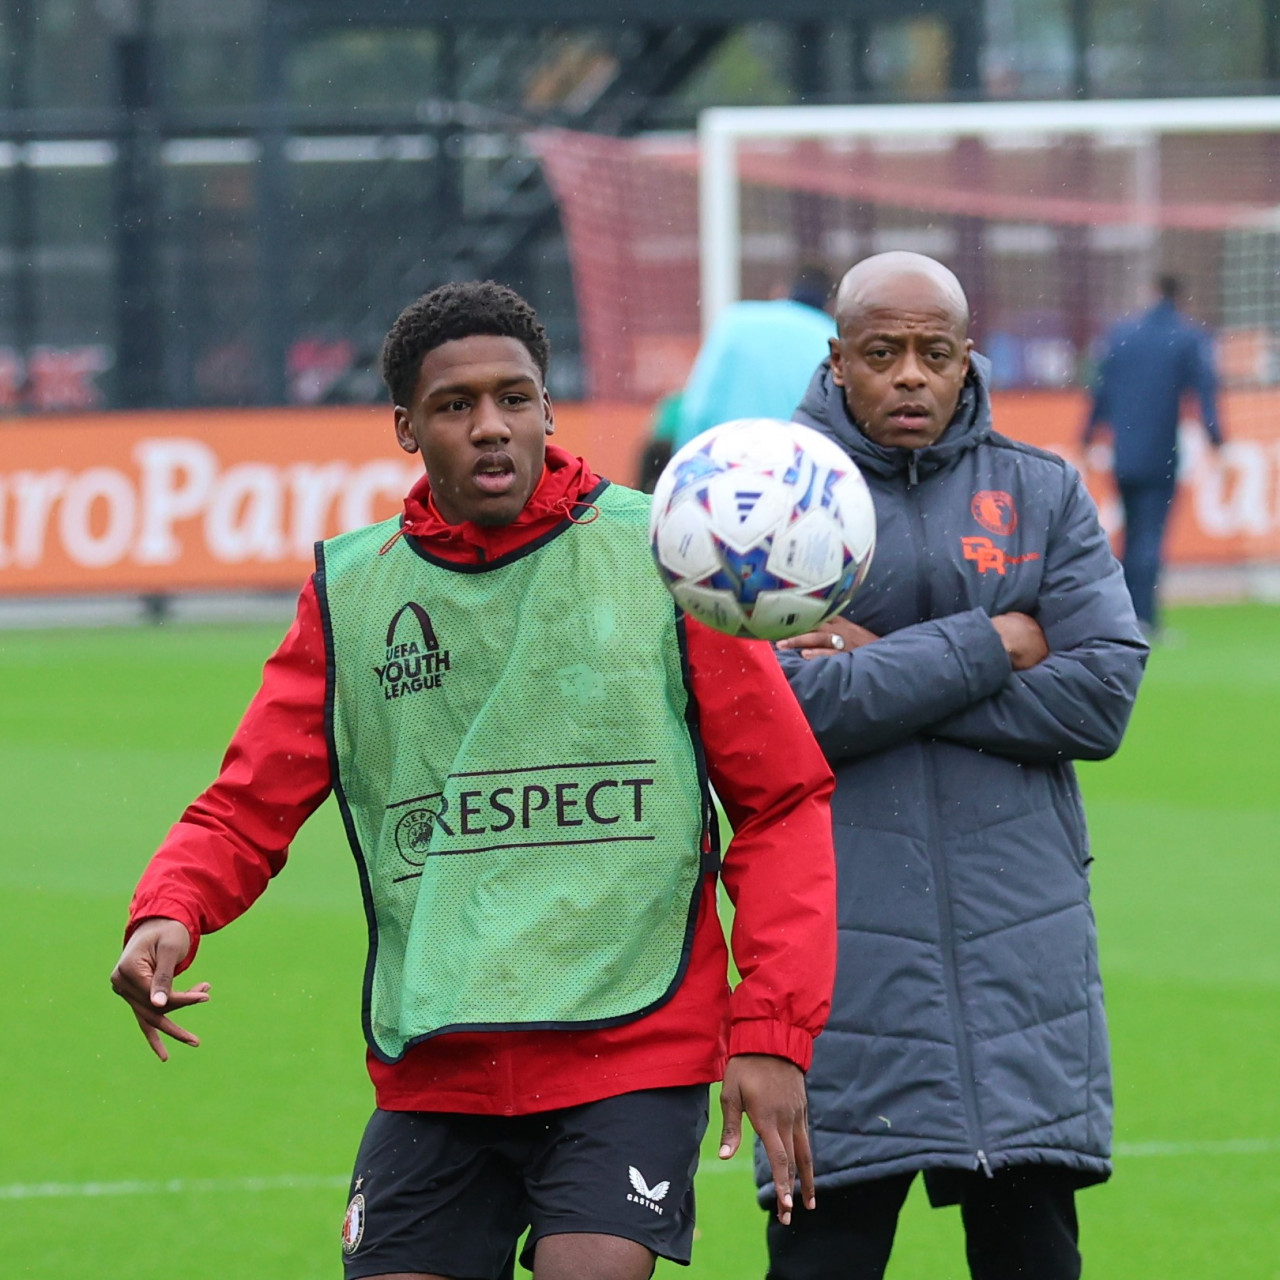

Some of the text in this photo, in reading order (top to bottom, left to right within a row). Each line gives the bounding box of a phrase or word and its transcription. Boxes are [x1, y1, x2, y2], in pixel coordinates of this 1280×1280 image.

[385, 641, 420, 661] UEFA
[373, 649, 451, 687] YOUTH
[384, 674, 442, 700] LEAGUE
[436, 778, 654, 836] RESPECT
[626, 1193, 664, 1215] CASTORE
